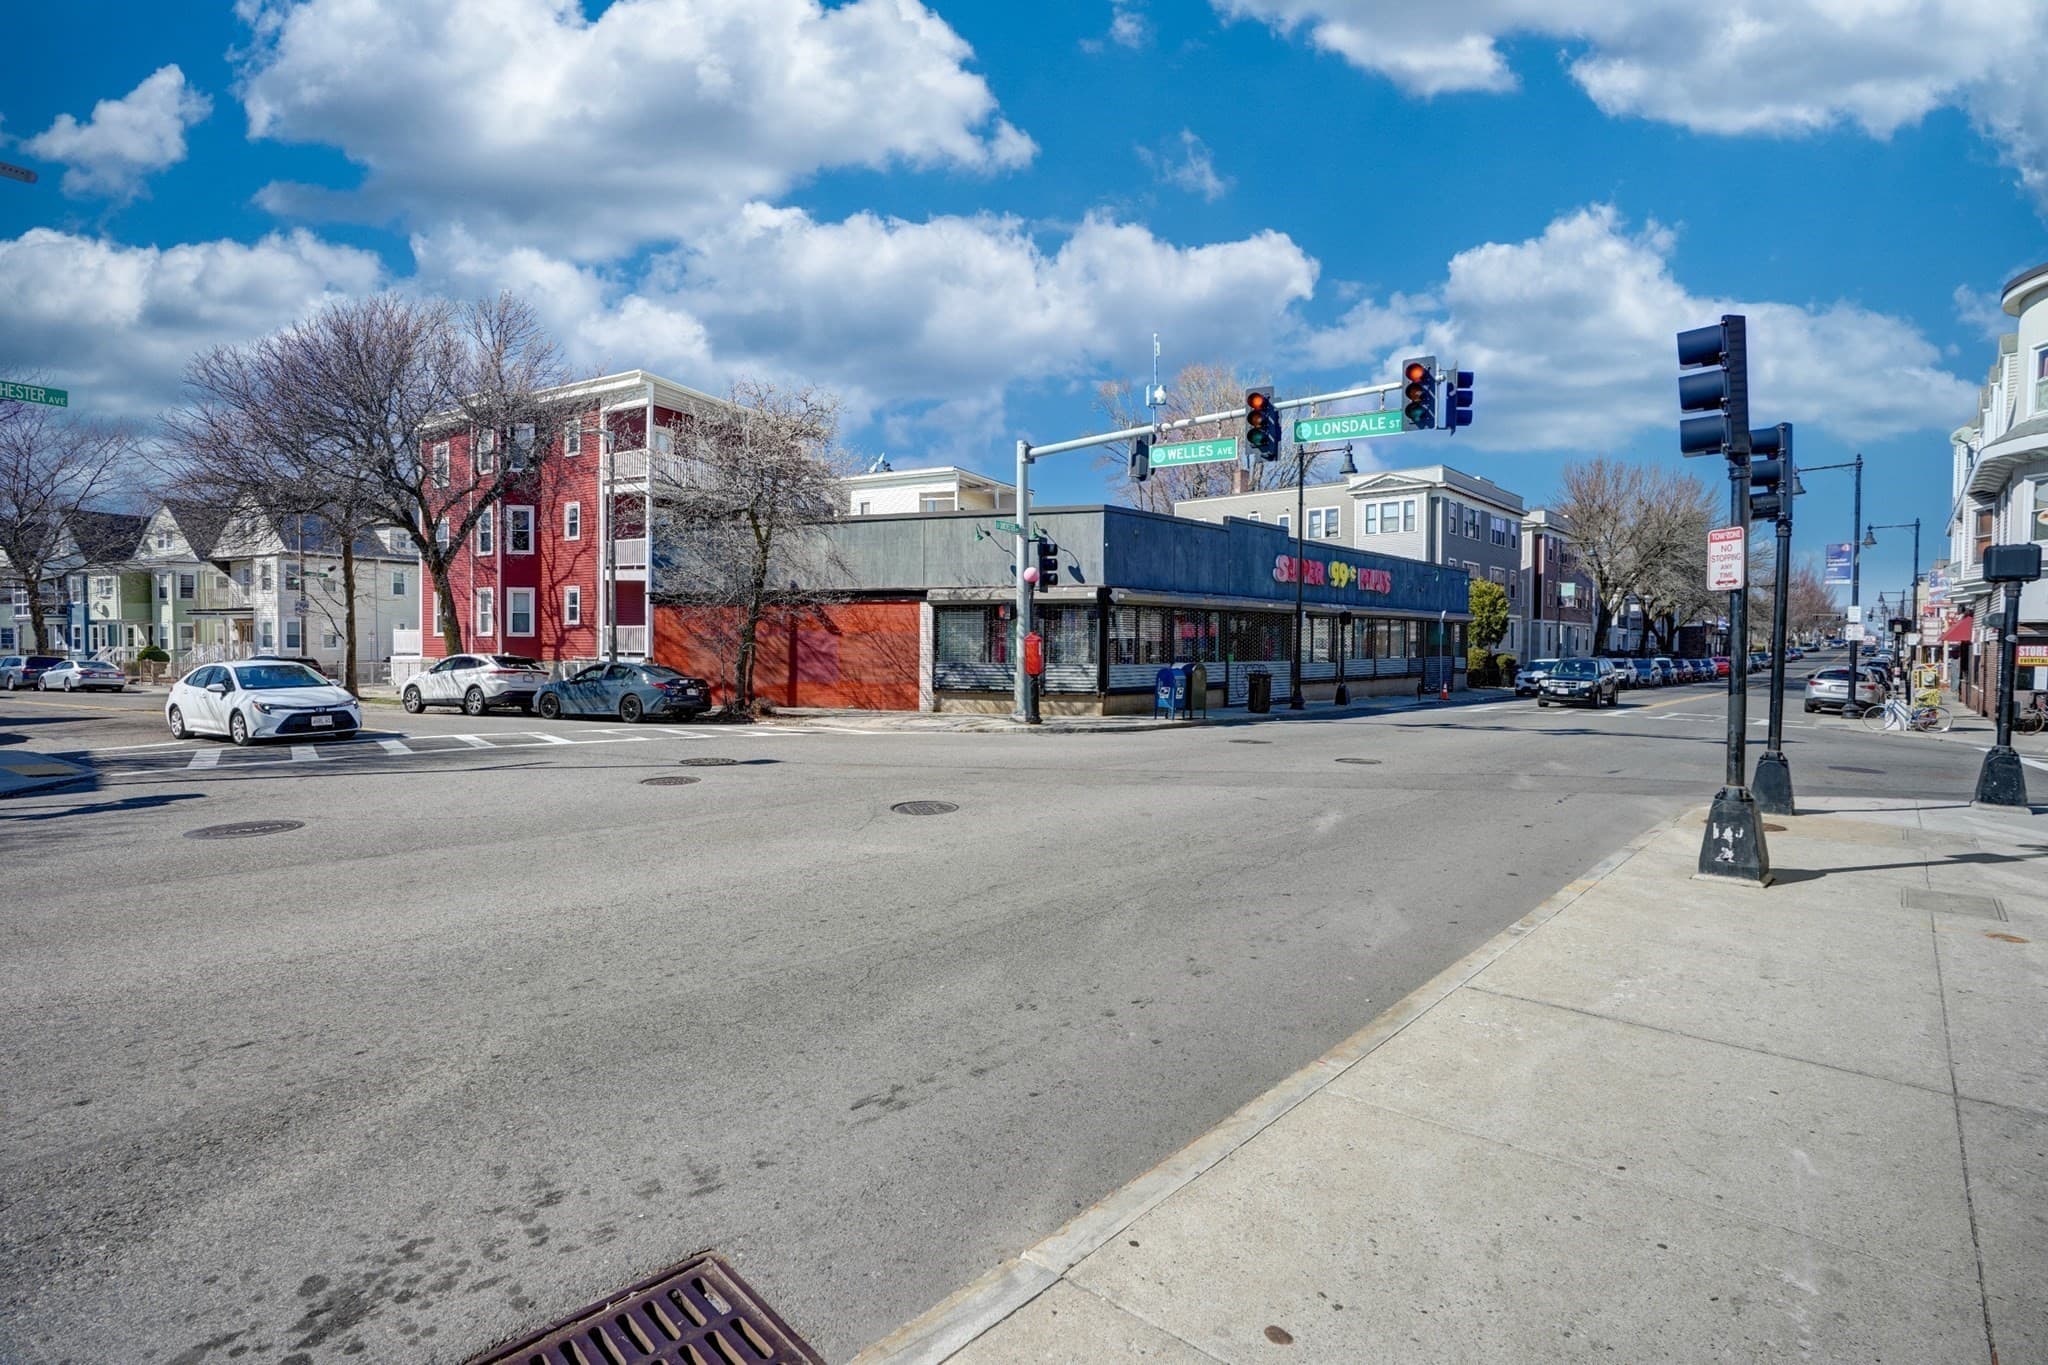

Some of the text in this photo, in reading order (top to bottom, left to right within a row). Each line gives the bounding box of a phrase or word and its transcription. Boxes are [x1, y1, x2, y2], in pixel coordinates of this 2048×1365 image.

[0, 383, 66, 405] HESTER AVE
[1315, 417, 1401, 436] LONSDALE ST
[1168, 445, 1233, 460] WELLES AVE
[1721, 544, 1733, 552] NO
[1711, 553, 1742, 563] STOPPING
[2019, 646, 2048, 657] STORE
